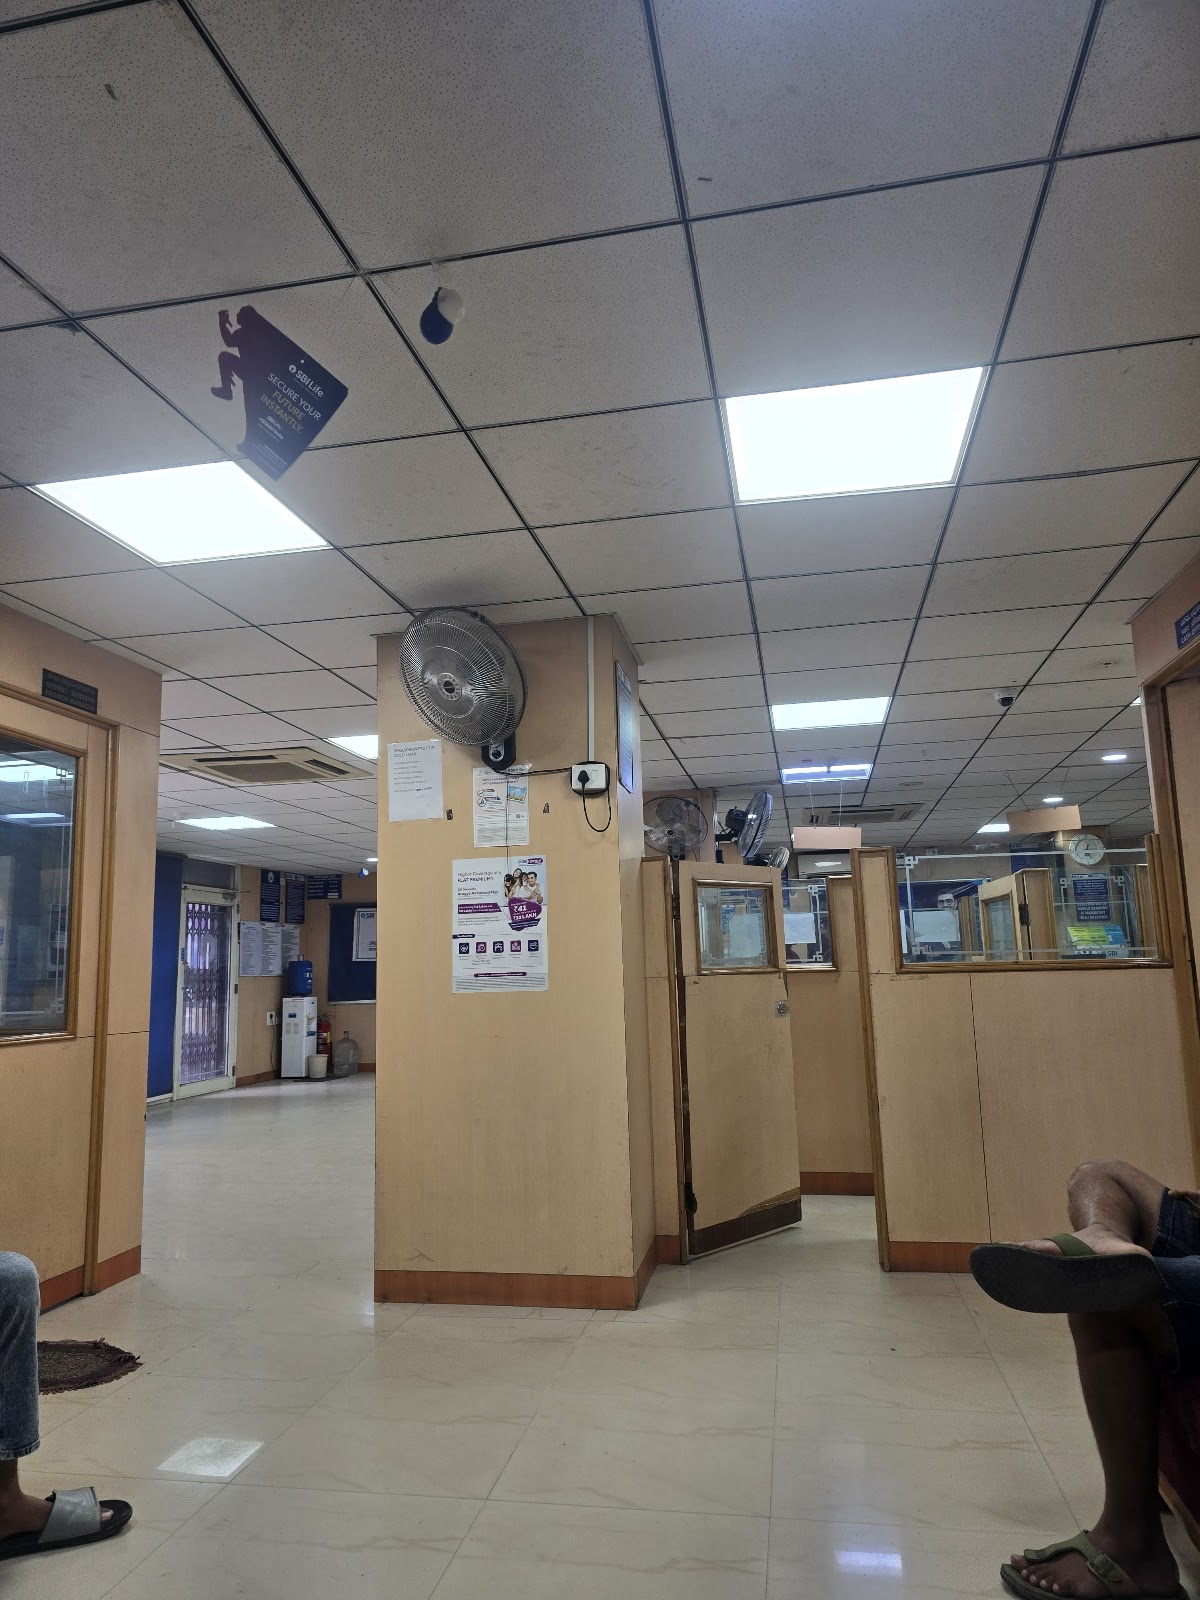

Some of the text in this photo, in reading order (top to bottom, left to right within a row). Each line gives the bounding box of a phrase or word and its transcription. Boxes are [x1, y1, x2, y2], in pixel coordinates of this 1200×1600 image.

[267, 373, 322, 421] SECURE YOUR
[296, 370, 324, 397] SBI Life
[260, 394, 304, 434] INSTANTLY.
[272, 391, 305, 421] FUTURE
